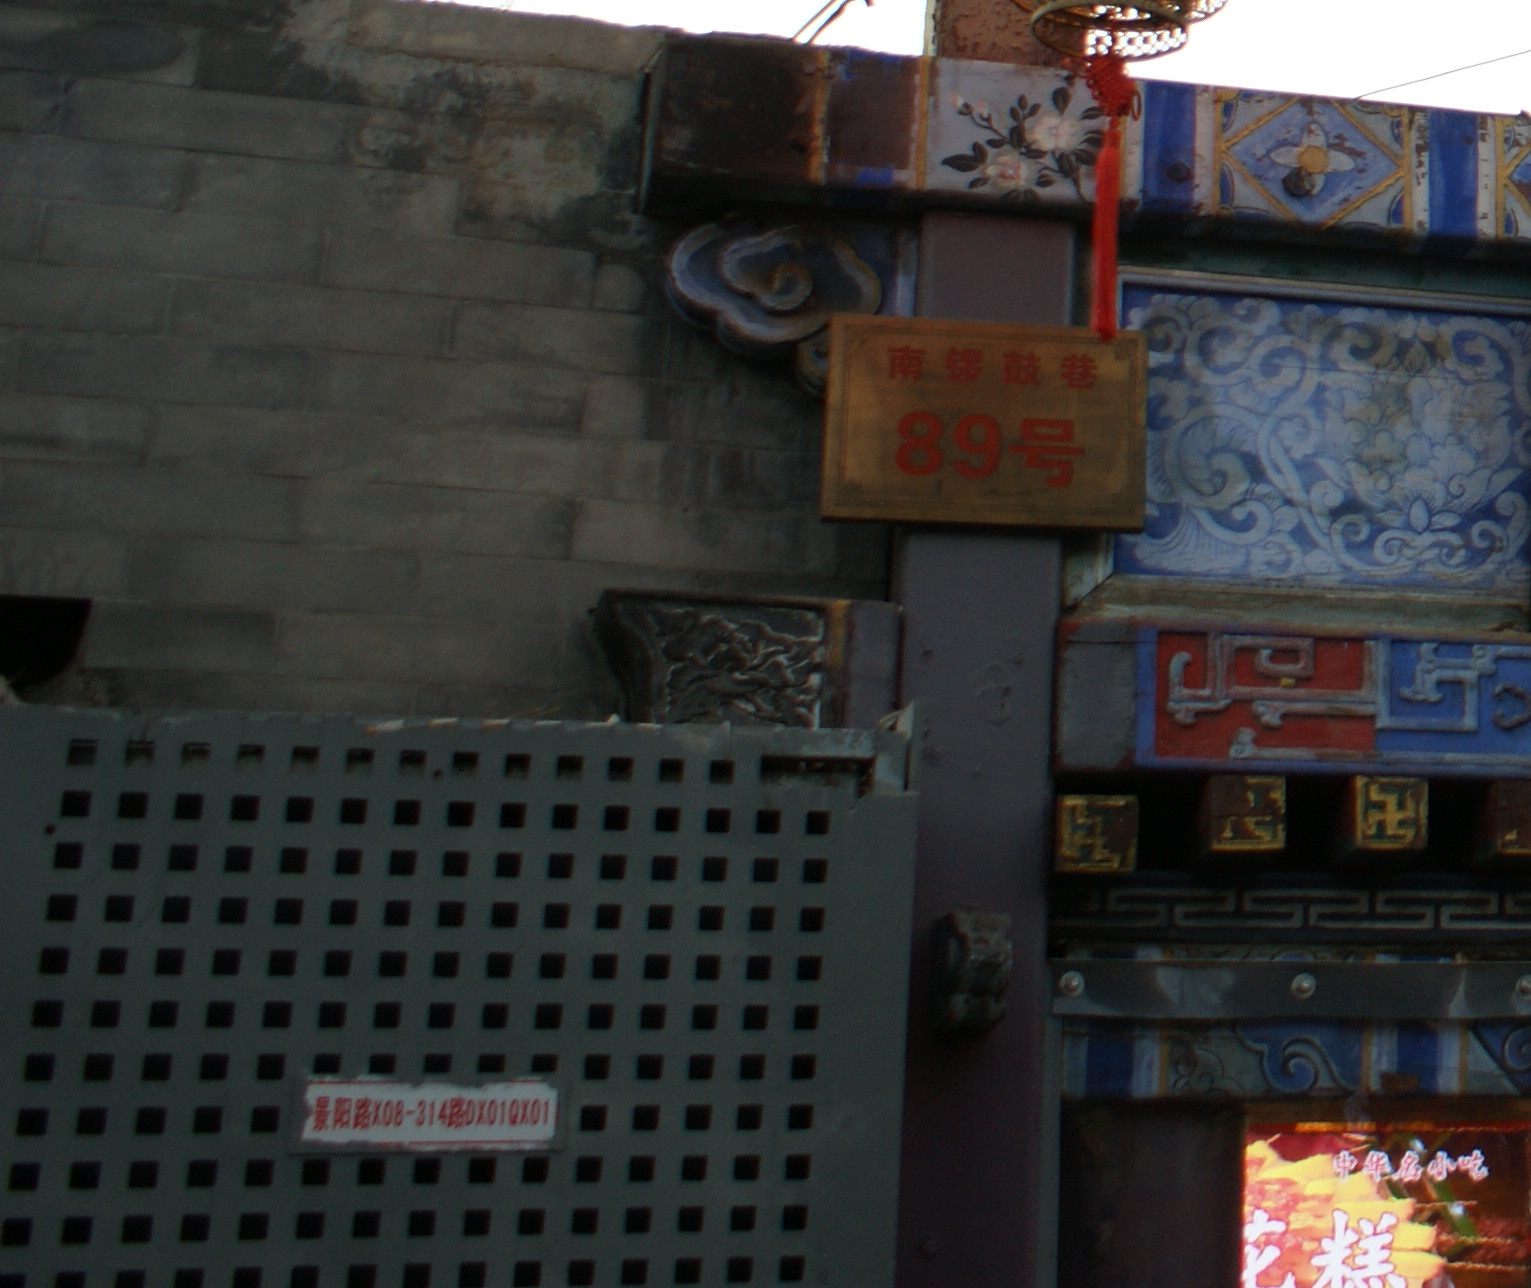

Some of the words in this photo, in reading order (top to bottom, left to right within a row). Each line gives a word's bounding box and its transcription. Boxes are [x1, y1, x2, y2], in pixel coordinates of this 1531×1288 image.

[887, 345, 1099, 391] 南锣鼓巷
[895, 412, 1086, 489] 89号
[1332, 1148, 1490, 1183] 中华名小吃
